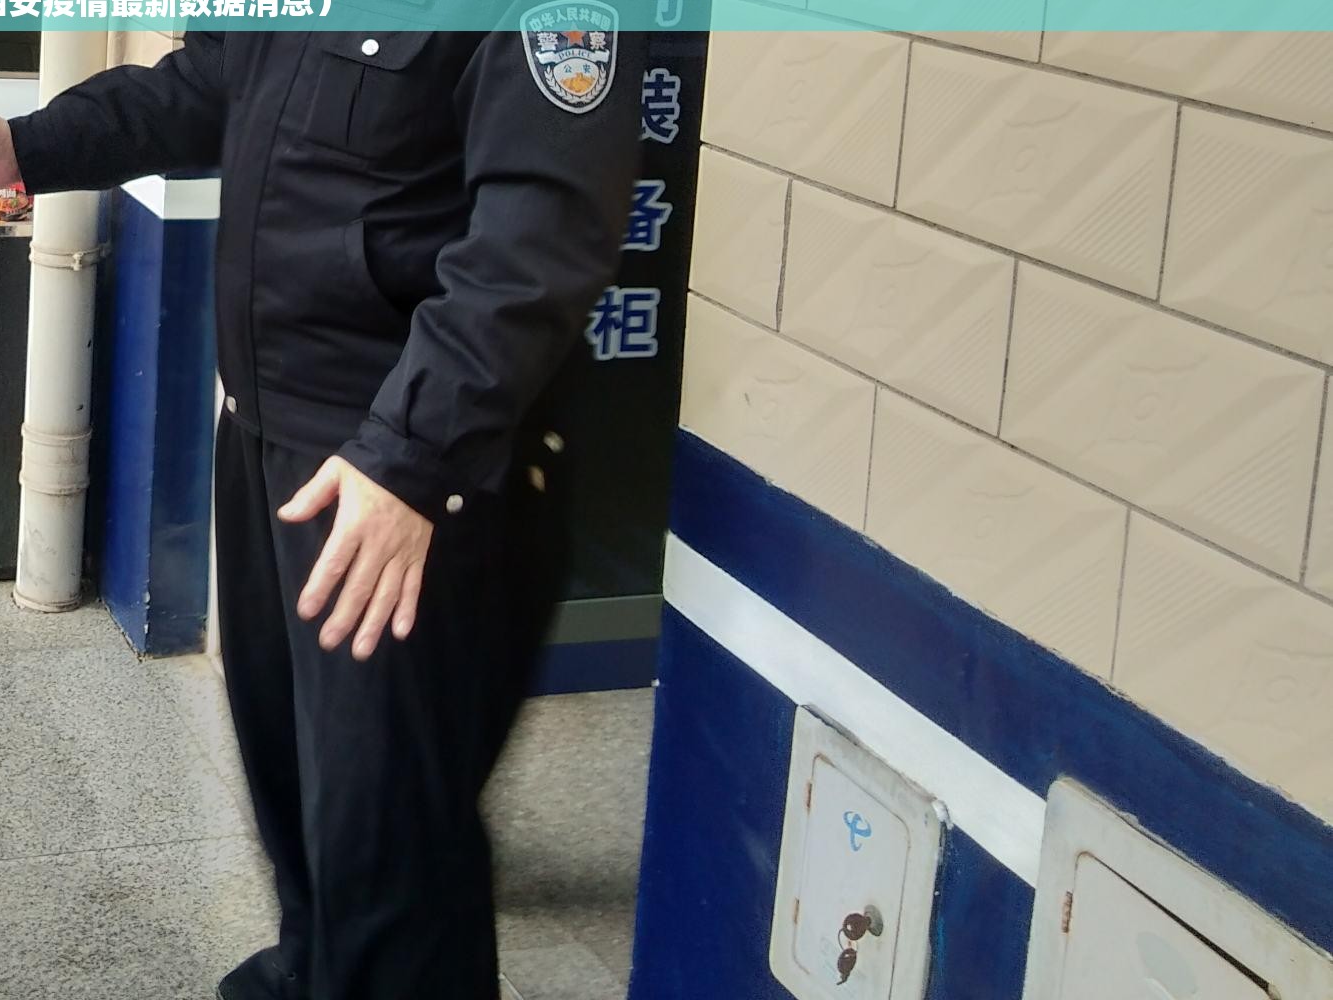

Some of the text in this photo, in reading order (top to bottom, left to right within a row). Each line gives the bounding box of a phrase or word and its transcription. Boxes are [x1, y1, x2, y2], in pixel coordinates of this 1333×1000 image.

[528, 6, 611, 33] 中华人民共和国
